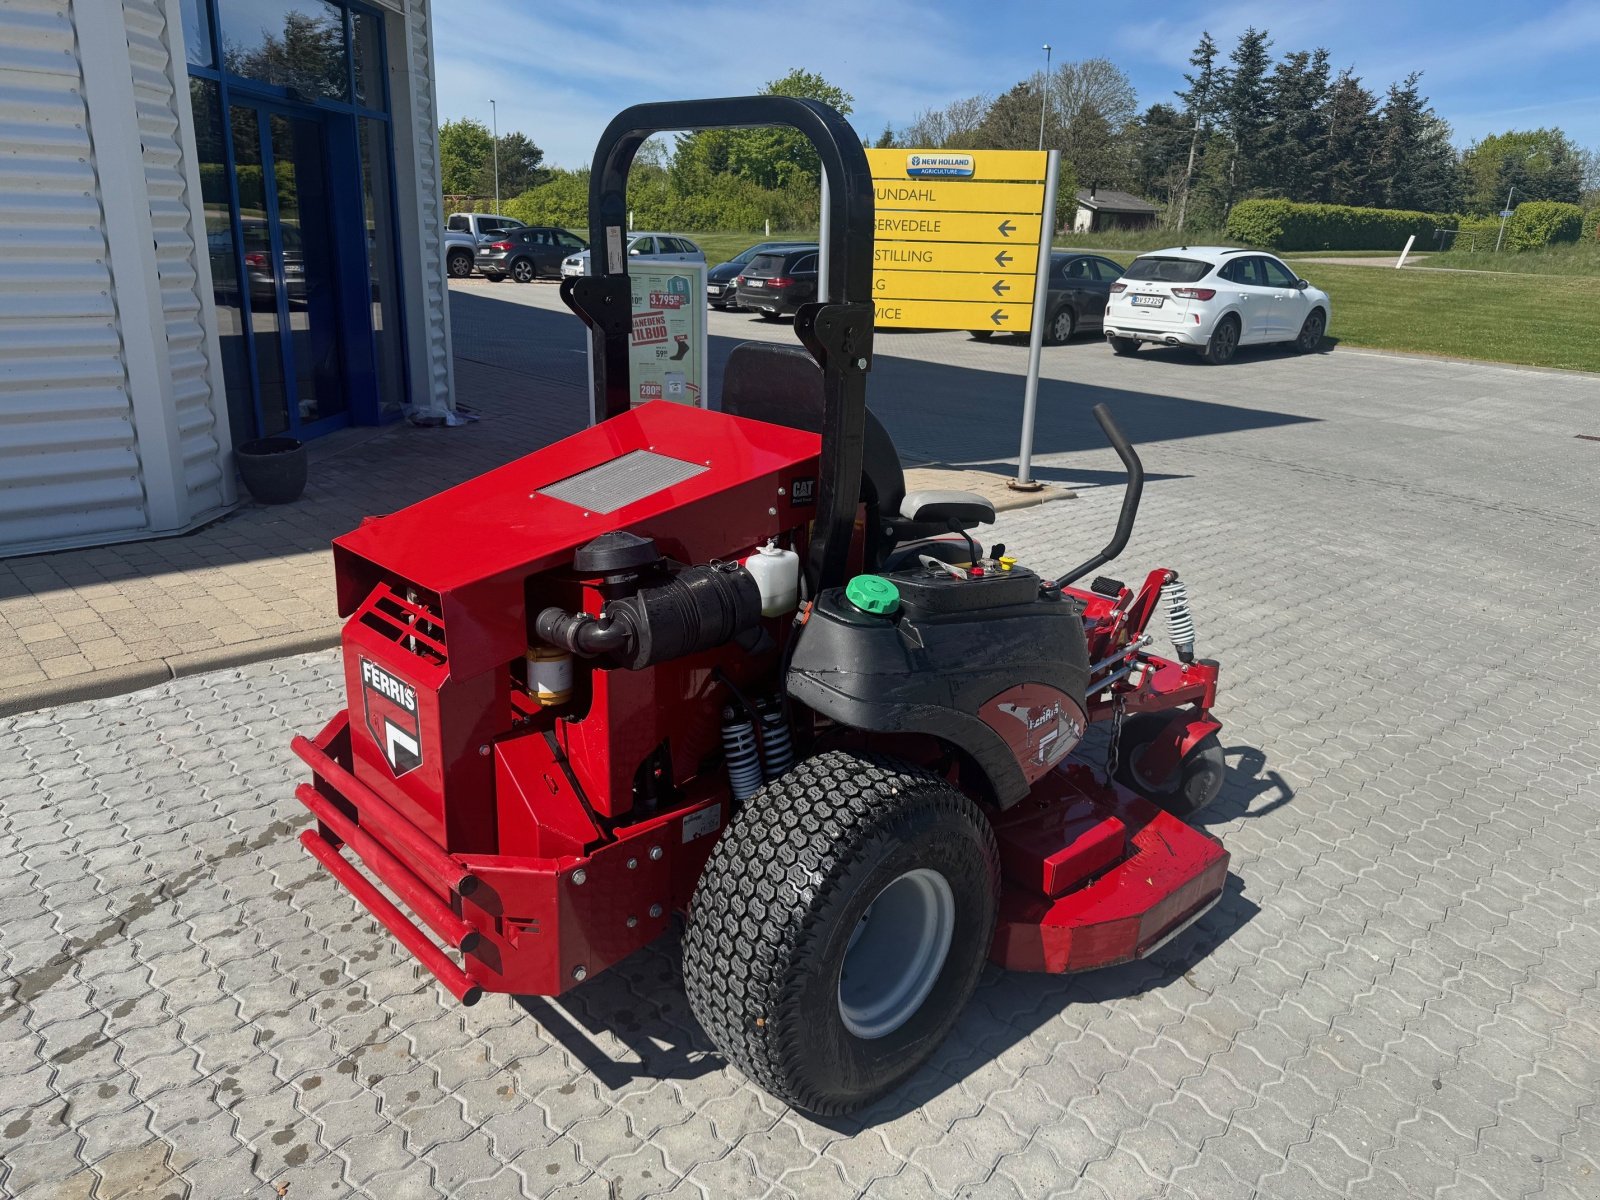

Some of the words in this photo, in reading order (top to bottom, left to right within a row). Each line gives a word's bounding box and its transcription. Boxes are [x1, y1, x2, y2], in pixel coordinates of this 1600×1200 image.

[921, 158, 938, 166] NEW
[938, 158, 969, 166] HOLLAND
[874, 188, 937, 202] UNDAHL
[874, 249, 933, 263] STILLING
[874, 307, 902, 320] VICE
[792, 480, 814, 497] CAT
[362, 660, 416, 711] FERRIS
